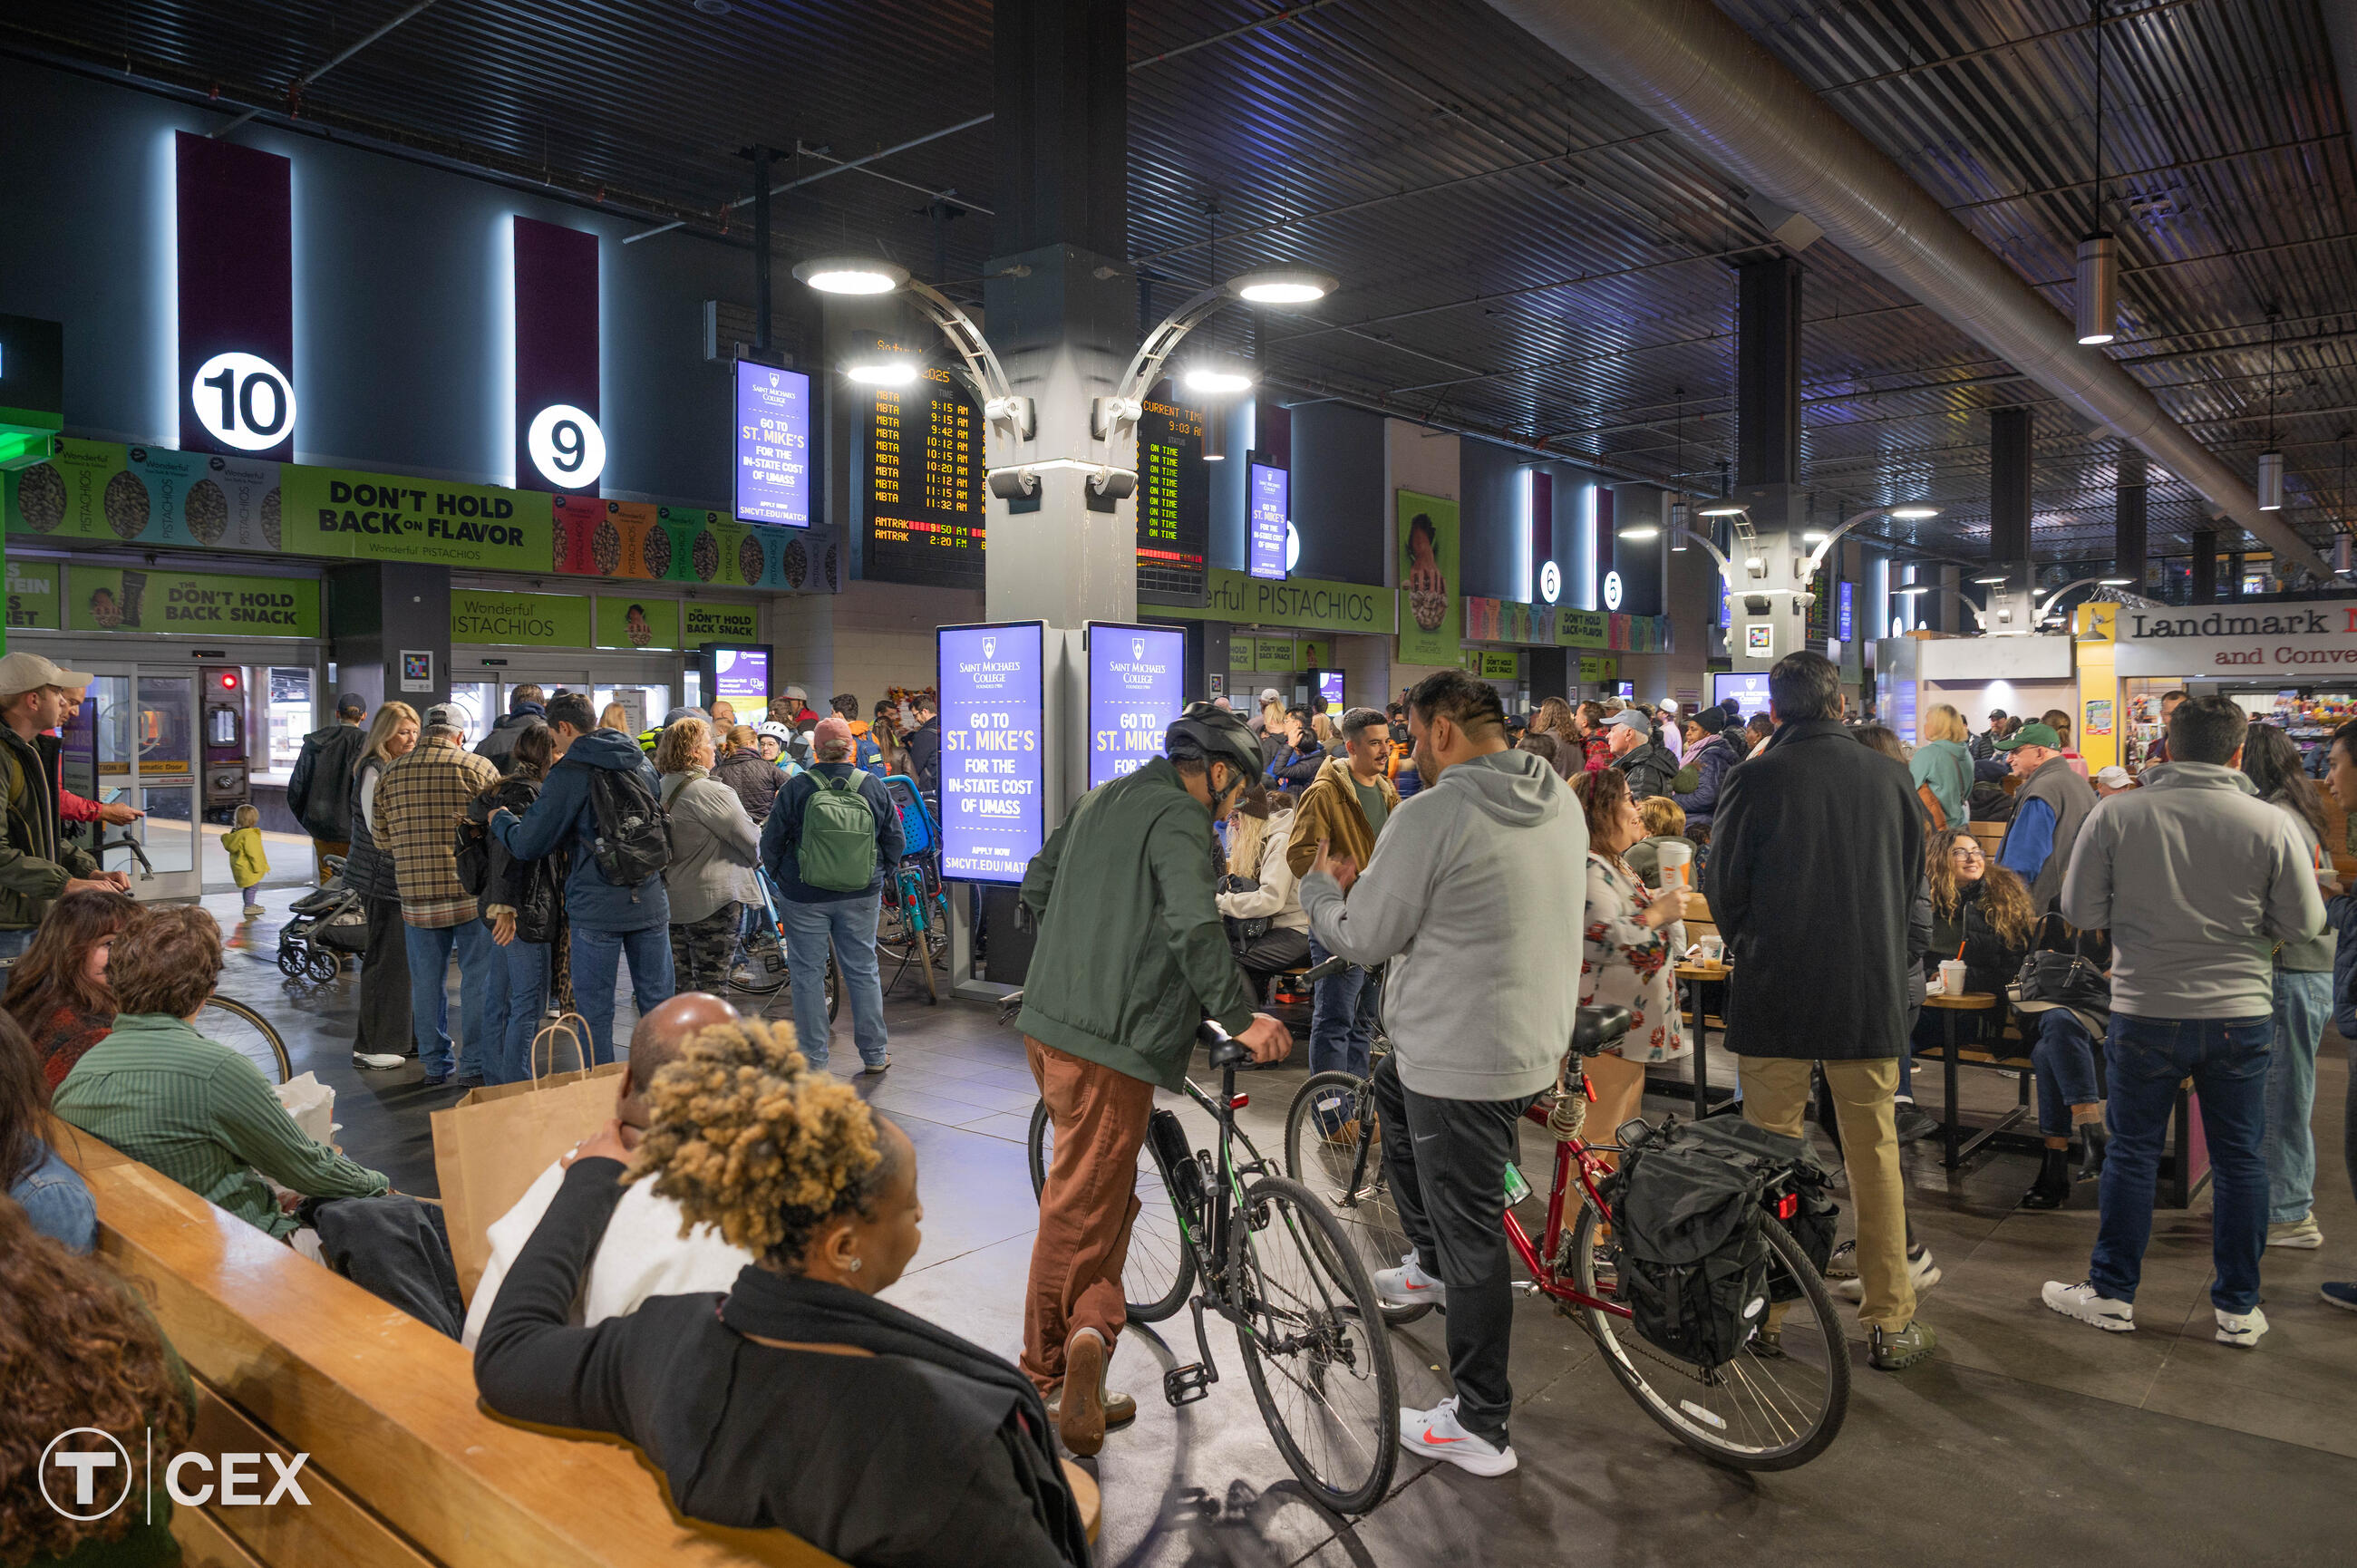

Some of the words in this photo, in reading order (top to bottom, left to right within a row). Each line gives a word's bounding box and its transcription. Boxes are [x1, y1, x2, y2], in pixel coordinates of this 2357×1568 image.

[921, 368, 950, 383] 2025
[752, 384, 769, 393] SAINT
[204, 368, 286, 436] 10
[763, 393, 785, 403] COLLEGE
[877, 390, 899, 402] MBTA
[931, 401, 953, 412] 9:15
[957, 406, 968, 415] AM
[877, 402, 899, 414] MBTA
[931, 413, 953, 425] 9:15
[957, 418, 968, 428] AM
[1143, 401, 1179, 417] CURRENT
[761, 418, 773, 429] GO
[776, 421, 788, 431] TO
[876, 415, 899, 427] MBTA
[931, 425, 953, 437] 9:42
[957, 430, 968, 440] AM
[1169, 421, 1189, 433] 9:03
[742, 426, 761, 440] ST.
[764, 431, 804, 449] MIKE'S
[876, 428, 899, 440] MBTA
[927, 437, 953, 449] 10:12
[957, 441, 968, 451] AM
[1168, 436, 1186, 446] STATUS
[551, 419, 586, 473] 9
[756, 446, 773, 458] FOR
[775, 449, 791, 460] THE
[876, 440, 899, 452] MBTA
[927, 449, 953, 461] 10:15
[957, 454, 968, 463] AM
[1150, 444, 1159, 453] ON
[1162, 446, 1178, 456] TIME
[146, 460, 189, 471] Wonderful
[743, 456, 781, 471] IN-STATE
[782, 462, 803, 474] COST
[876, 453, 899, 465] MBTA
[927, 461, 952, 473] 10:20
[957, 466, 968, 476] AM
[1150, 454, 1159, 463] ON
[1162, 457, 1178, 467] TIME
[225, 469, 264, 479] Wonderful
[752, 471, 765, 480] OF
[766, 473, 795, 485] UMASS
[876, 466, 898, 478] MBTA
[926, 473, 952, 486] 11:12
[957, 479, 967, 488] AM
[1150, 465, 1159, 474] ON
[1162, 467, 1178, 477] TIME
[875, 479, 898, 490] MBTA
[926, 486, 952, 498] 11:15
[956, 490, 967, 499] AM
[1150, 476, 1159, 485] ON
[1162, 478, 1178, 488] TIME
[330, 480, 426, 511] DON'T
[437, 495, 513, 518] HOLD
[1149, 486, 1159, 495] ON
[1162, 489, 1178, 498] TIME
[80, 469, 92, 532] PISTACHIOS
[875, 491, 898, 503] MBTA
[926, 498, 952, 510] 11:32
[956, 502, 967, 512] AM
[1149, 497, 1159, 506] ON
[1162, 498, 1178, 508] TIME
[162, 479, 173, 538] PISTACHIOS
[239, 487, 250, 545] PISTACHIOS
[741, 507, 806, 522] SMCVT.EDU/MATCH
[1149, 507, 1159, 516] ON
[1162, 509, 1178, 519] TIME
[319, 509, 403, 535] BACK
[403, 520, 422, 531] ON
[428, 518, 524, 546] FLAVOR
[875, 517, 908, 529] AMTRAK
[930, 523, 952, 535] 9:50
[1149, 518, 1158, 527] ON
[1161, 520, 1178, 530] TIME
[875, 529, 908, 542] AMTRAK
[930, 536, 952, 547] 2:20
[1149, 528, 1158, 537] ON
[1161, 530, 1177, 540] TIME
[370, 544, 418, 555] Wonderful
[422, 547, 480, 560] PISTACHIOS
[1547, 569, 1555, 595] 6
[1609, 577, 1616, 602] 5
[169, 588, 234, 606] DON'T
[240, 592, 294, 608] HOLD
[1206, 580, 1246, 612] erful
[1257, 585, 1372, 623] PISTACHIOS
[166, 605, 221, 621] BACK
[230, 607, 296, 625] SNACK
[464, 601, 536, 616] Wonderful
[453, 616, 554, 636] ISTACHIOS
[689, 614, 721, 624] DON'T
[724, 616, 751, 624] HOLD
[1565, 614, 1584, 624] DON'T
[1586, 615, 1601, 625] HOLD
[2131, 609, 2330, 638] Landmark
[687, 624, 714, 633] BACK
[719, 625, 752, 636] SNACK
[1562, 624, 1577, 634] BACK
[1582, 627, 1603, 637] FLAVOR
[2215, 647, 2266, 664] and
[960, 663, 980, 673] SAINT
[983, 662, 1020, 672] MICHAEL'S
[1110, 662, 1130, 673] SAINT
[1131, 663, 1165, 673] MICHAEL'S
[974, 673, 1005, 683] COLLEGE
[1123, 673, 1152, 683] COLLEGE
[971, 713, 988, 728] GO
[992, 713, 1009, 728] TO
[1120, 714, 1137, 729] GO
[1140, 714, 1155, 728] TO
[947, 731, 971, 750] ST.
[976, 731, 1034, 750] MIKE'S
[1097, 731, 1120, 751] ST.
[1124, 731, 1167, 750] MIKE'
[965, 760, 988, 773] FOR
[992, 760, 1015, 773] THE
[1115, 760, 1137, 773] FOR
[949, 779, 999, 793] IN-STATE
[1002, 780, 1033, 794] COST
[961, 799, 976, 813] OF
[980, 799, 1020, 814] UMASS
[972, 847, 992, 856] APPLY
[994, 847, 1010, 857] NOW
[946, 857, 1028, 874] SMCVT.EDU/MAT
